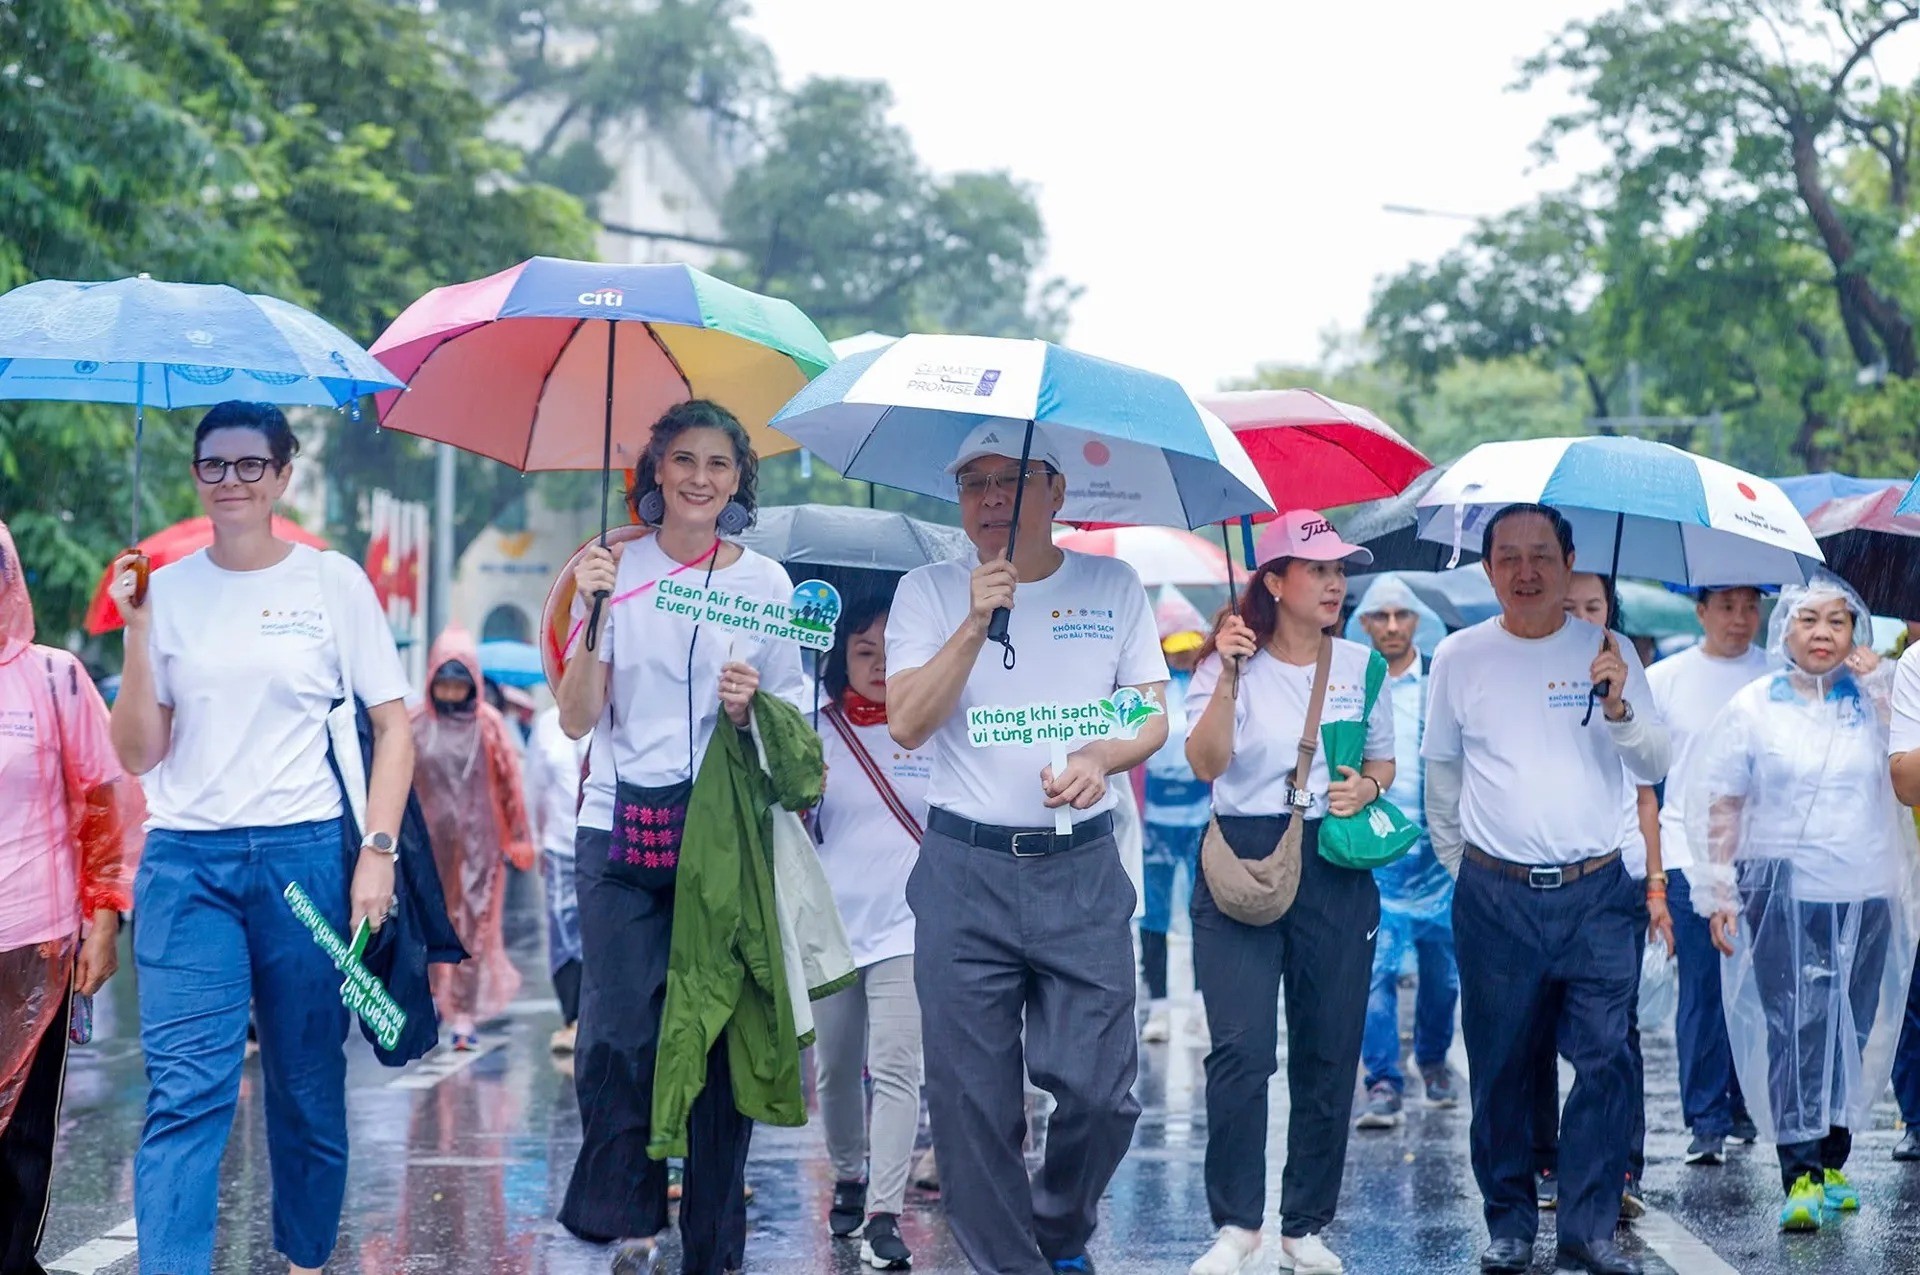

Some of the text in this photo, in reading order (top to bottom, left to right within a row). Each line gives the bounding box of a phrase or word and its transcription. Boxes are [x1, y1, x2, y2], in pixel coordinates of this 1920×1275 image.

[578, 291, 623, 307] citi
[916, 363, 983, 377] CLIMATE
[907, 379, 975, 396] PROMISE
[658, 579, 786, 620] Clean Air for All
[655, 596, 830, 647] Every breath matters
[1052, 623, 1082, 633] KHÔNG
[1053, 633, 1069, 641] CHO
[971, 703, 1099, 727] Không khí sạch
[992, 726, 1033, 744] từng
[1037, 722, 1074, 742] nhịp
[1078, 720, 1111, 736] thở
[317, 921, 348, 967] breath
[345, 954, 373, 991] every
[369, 976, 407, 1029] Making
[364, 998, 399, 1047] Clean
